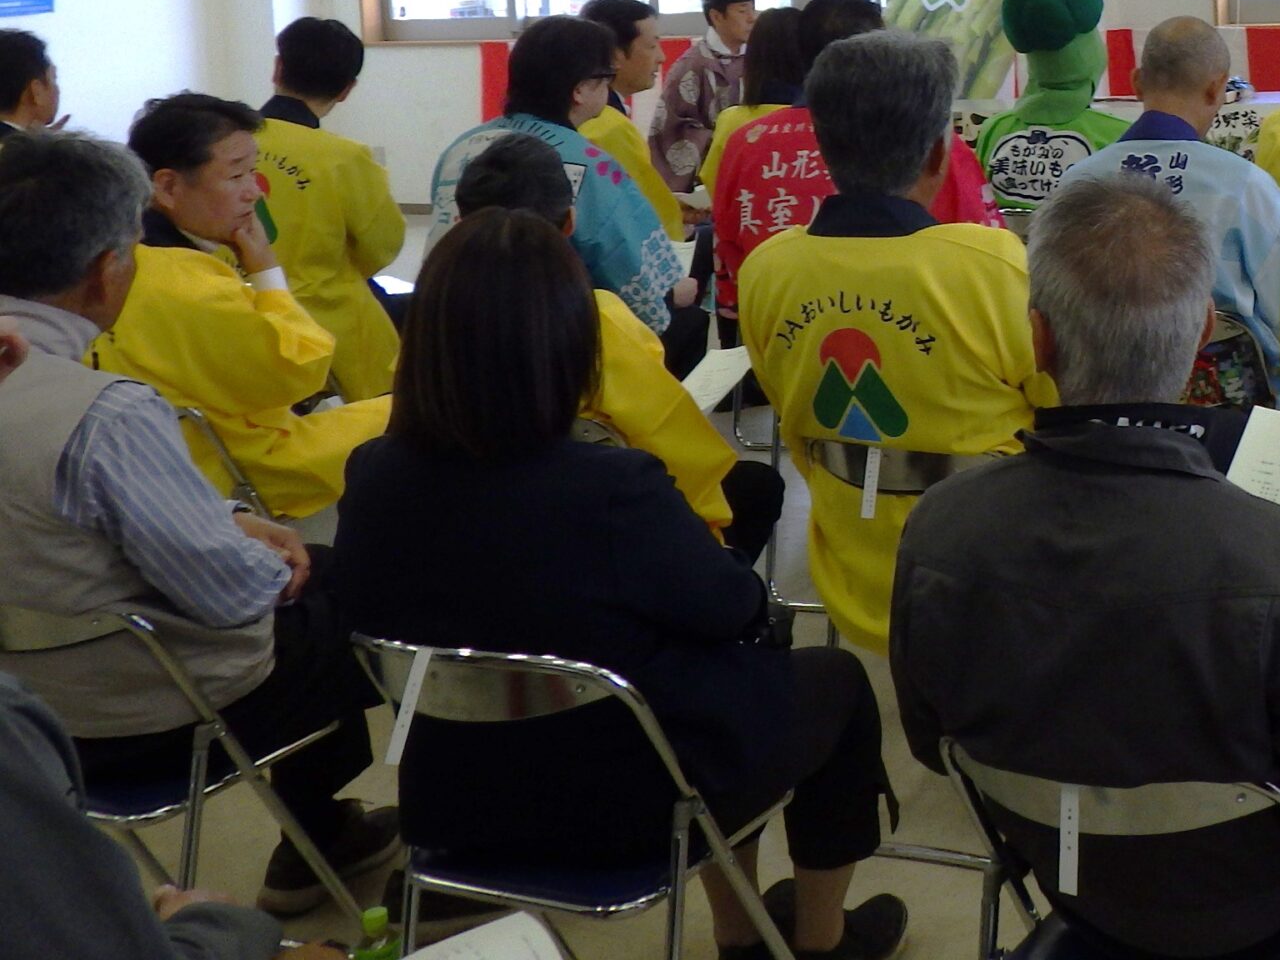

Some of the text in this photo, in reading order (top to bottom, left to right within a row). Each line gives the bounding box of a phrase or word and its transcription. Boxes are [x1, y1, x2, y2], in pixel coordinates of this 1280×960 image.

[762, 150, 832, 180] 山形
[991, 157, 1076, 178] 美味いも
[776, 291, 936, 355] JAおいしいもがみ
